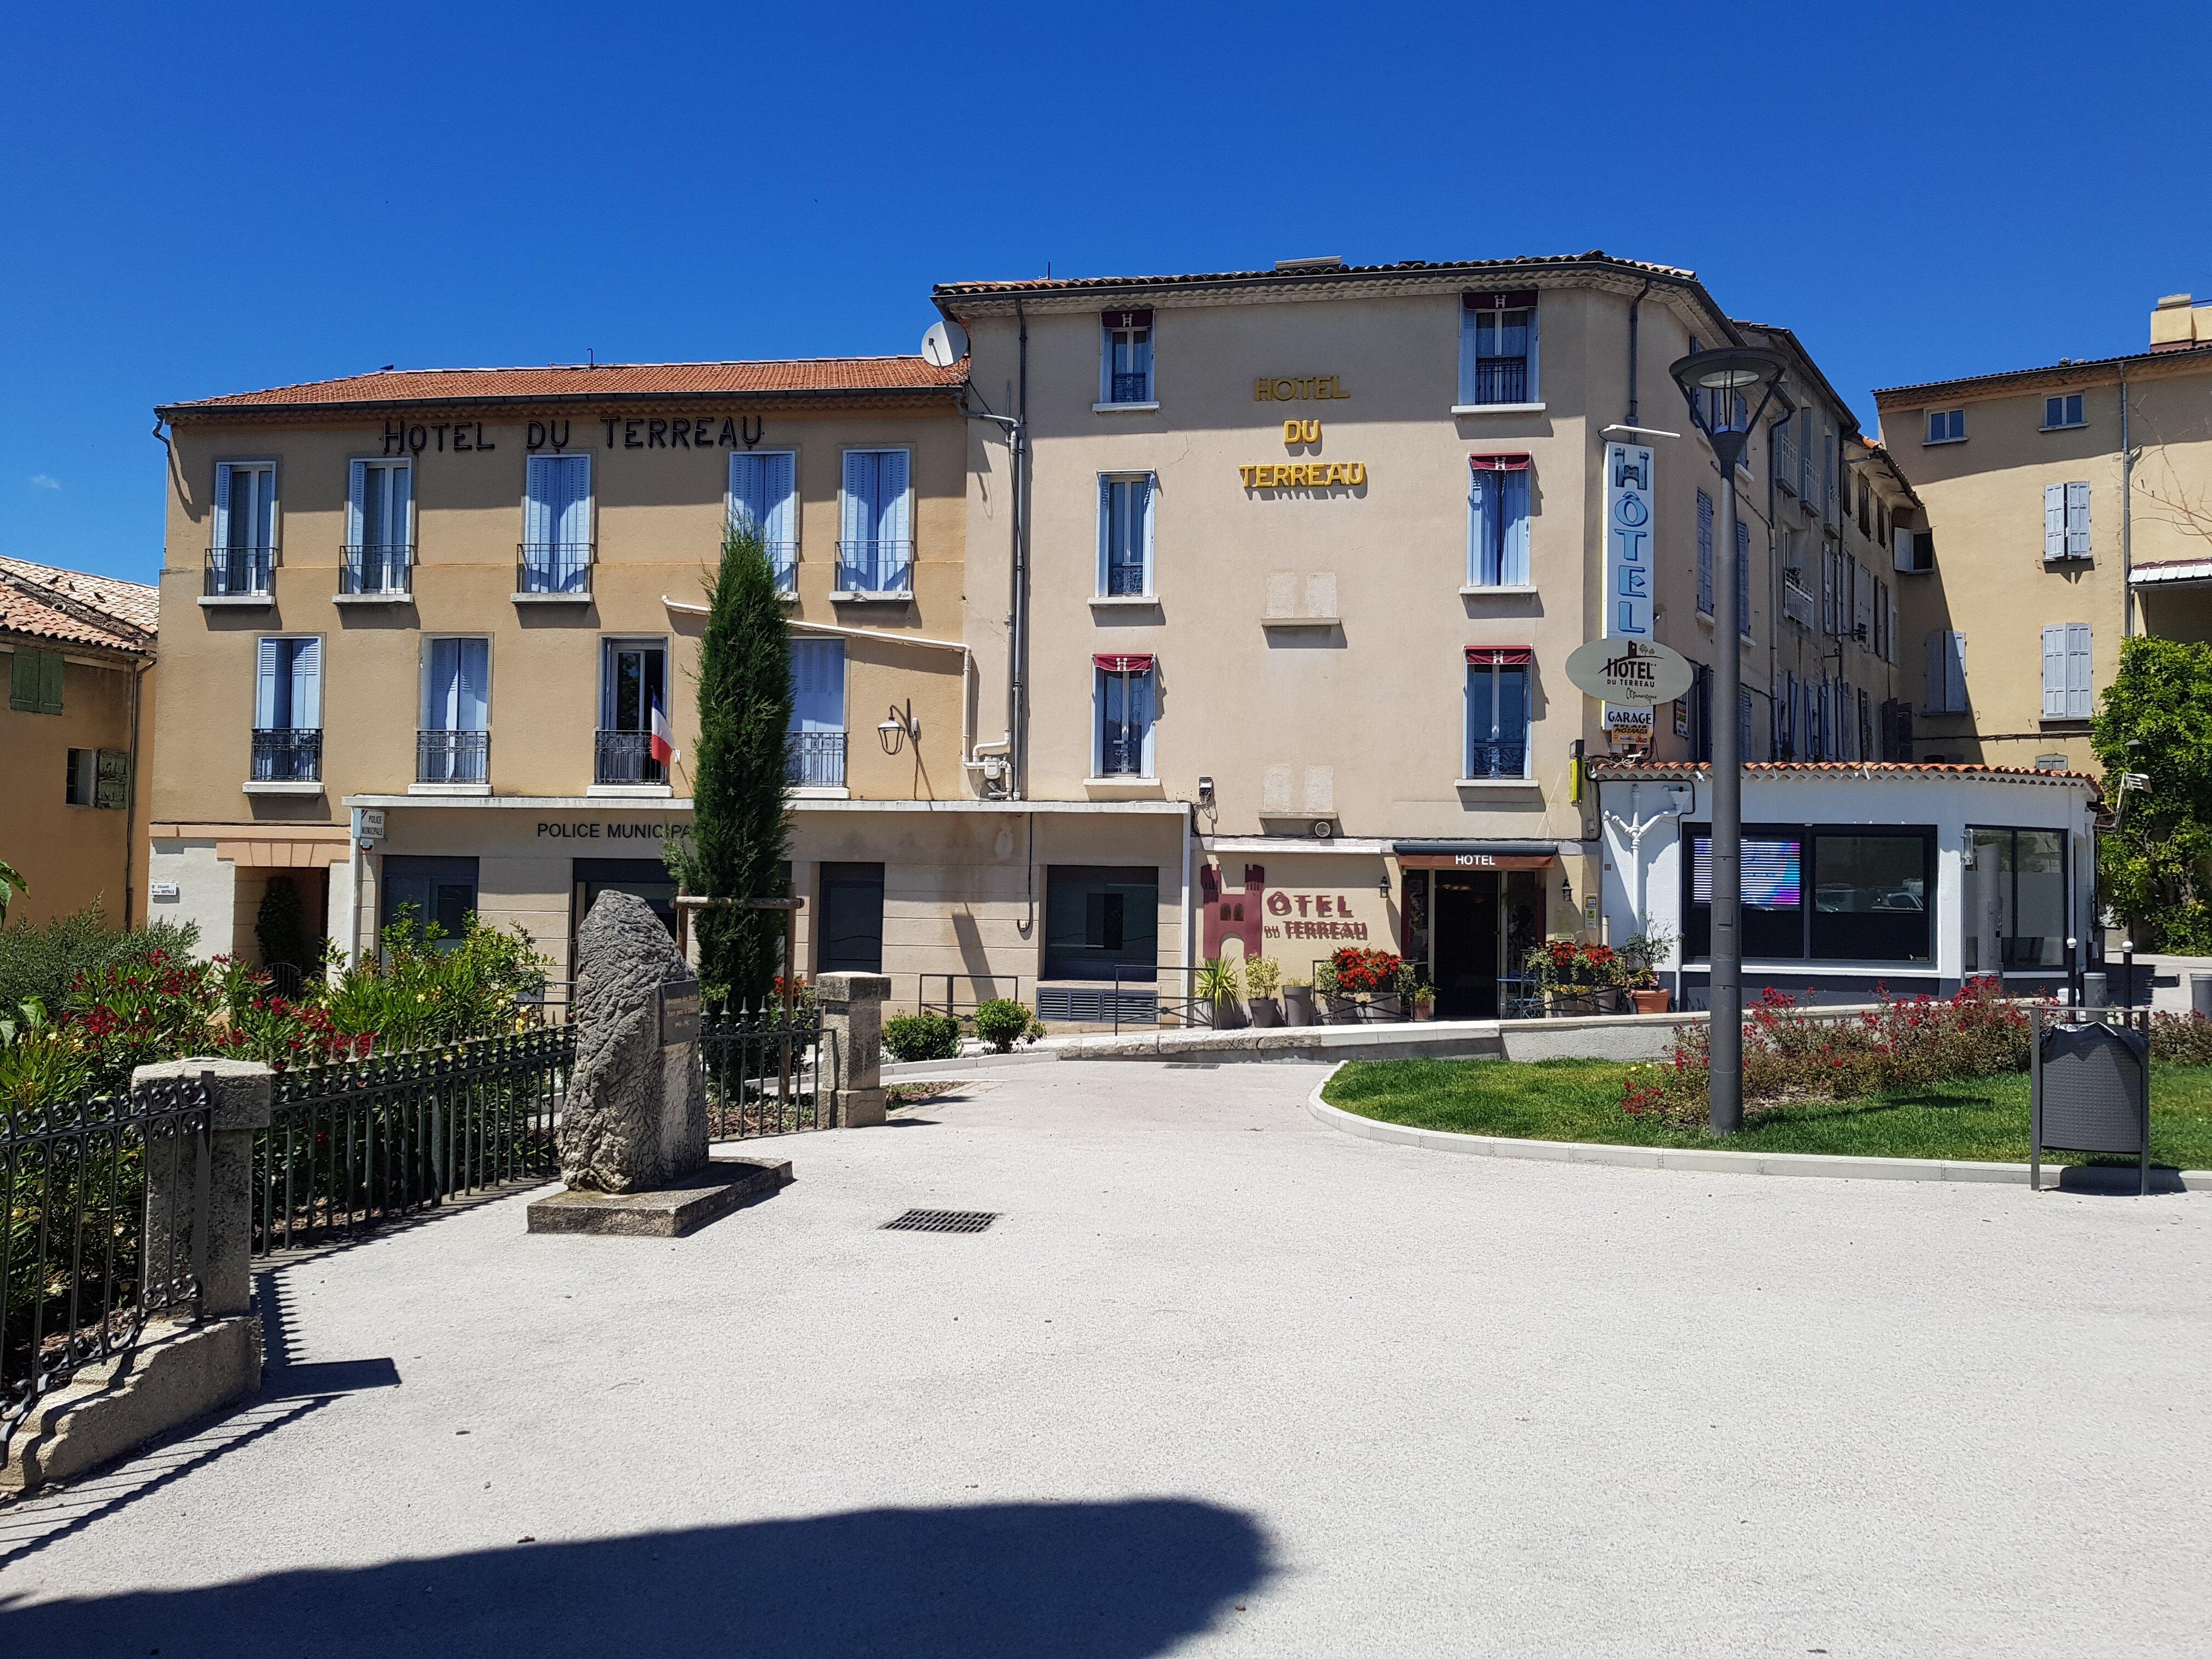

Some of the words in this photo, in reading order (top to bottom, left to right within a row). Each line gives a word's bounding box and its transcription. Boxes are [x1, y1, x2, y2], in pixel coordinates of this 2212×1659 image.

[1254, 376, 1350, 402] HOTEL
[384, 420, 495, 452] HOTEL
[526, 420, 569, 449] DU
[601, 415, 762, 448] TERREAU
[1284, 420, 1319, 443] DU
[1239, 462, 1364, 488] TERREAU
[1607, 658, 1655, 680] HOTEL
[1608, 711, 1651, 724] GARAGE
[369, 815, 382, 824] POLICE
[537, 823, 600, 837] POLICE
[607, 824, 692, 838] MUNICIPA
[1455, 854, 1496, 865] HOTEL
[1283, 921, 1368, 940] TERREAU
